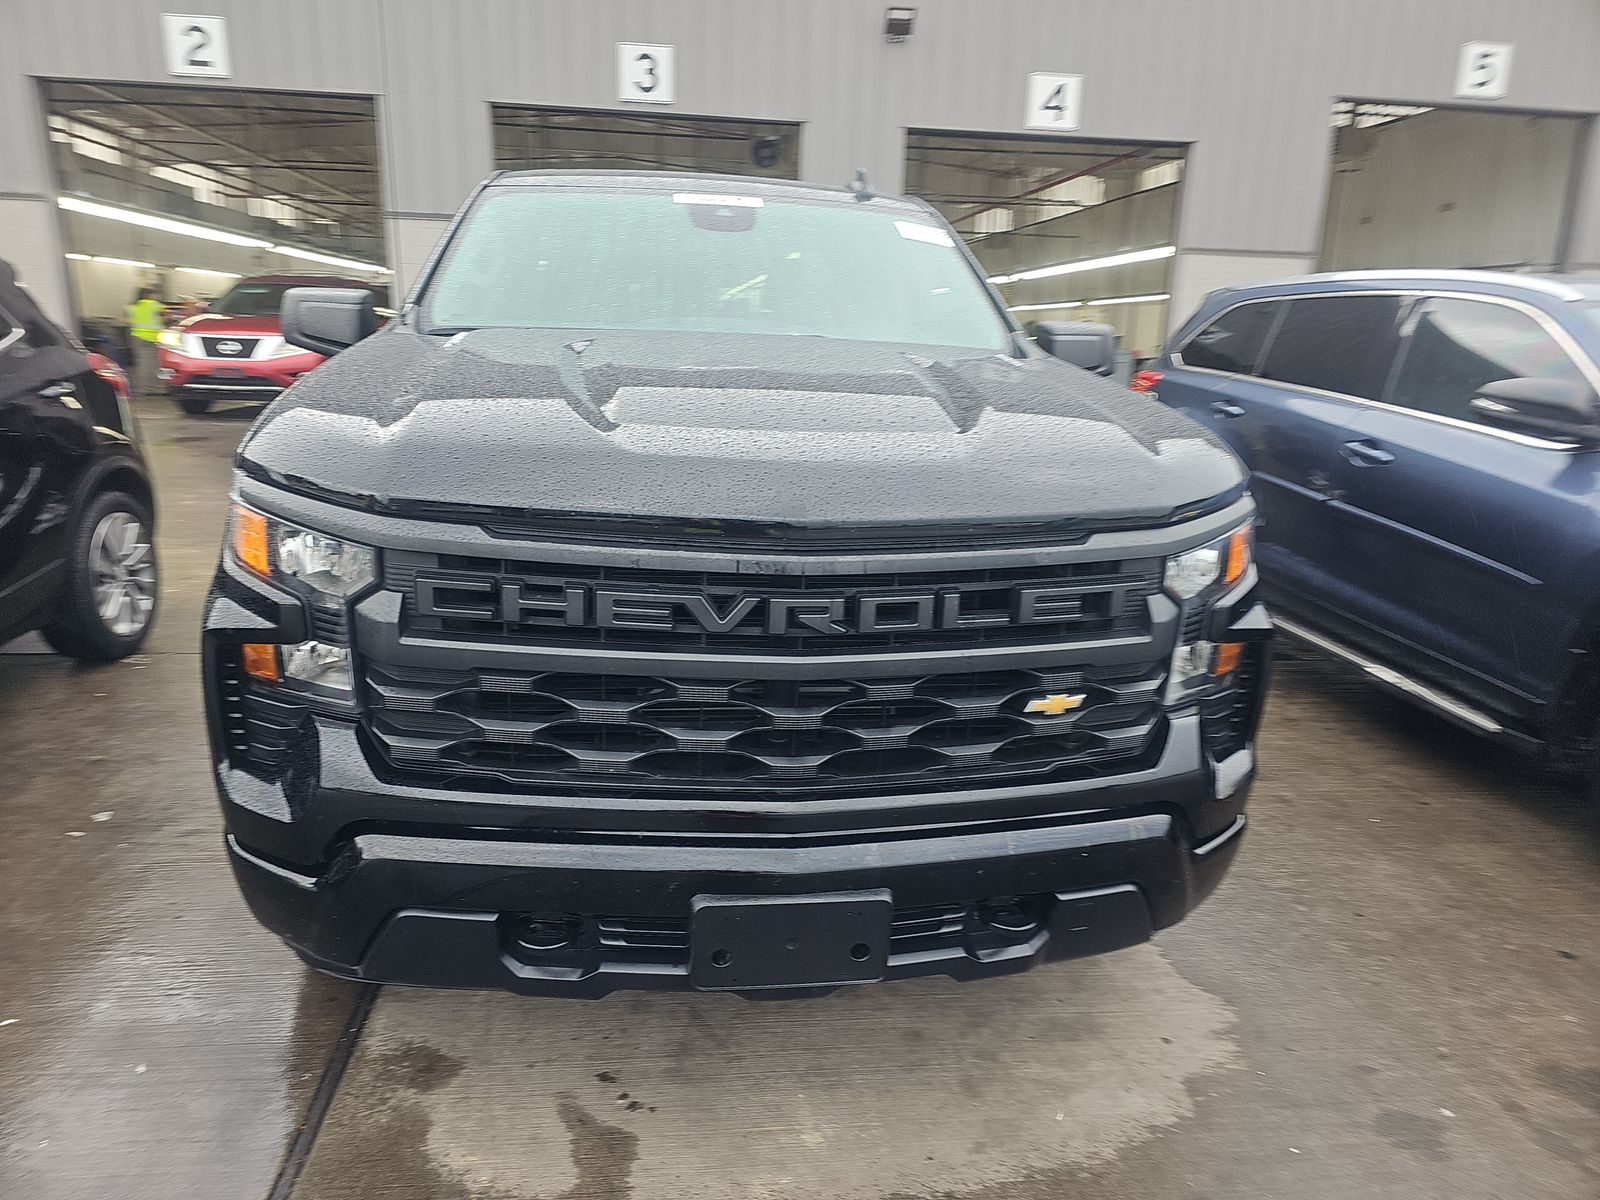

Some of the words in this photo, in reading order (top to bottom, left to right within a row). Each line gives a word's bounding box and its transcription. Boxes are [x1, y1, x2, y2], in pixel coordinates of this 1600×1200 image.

[182, 25, 214, 67] 2
[632, 53, 658, 92] 3
[1472, 50, 1498, 90] 5
[1038, 83, 1066, 121] 4
[414, 576, 1149, 635] CHEVROLET
